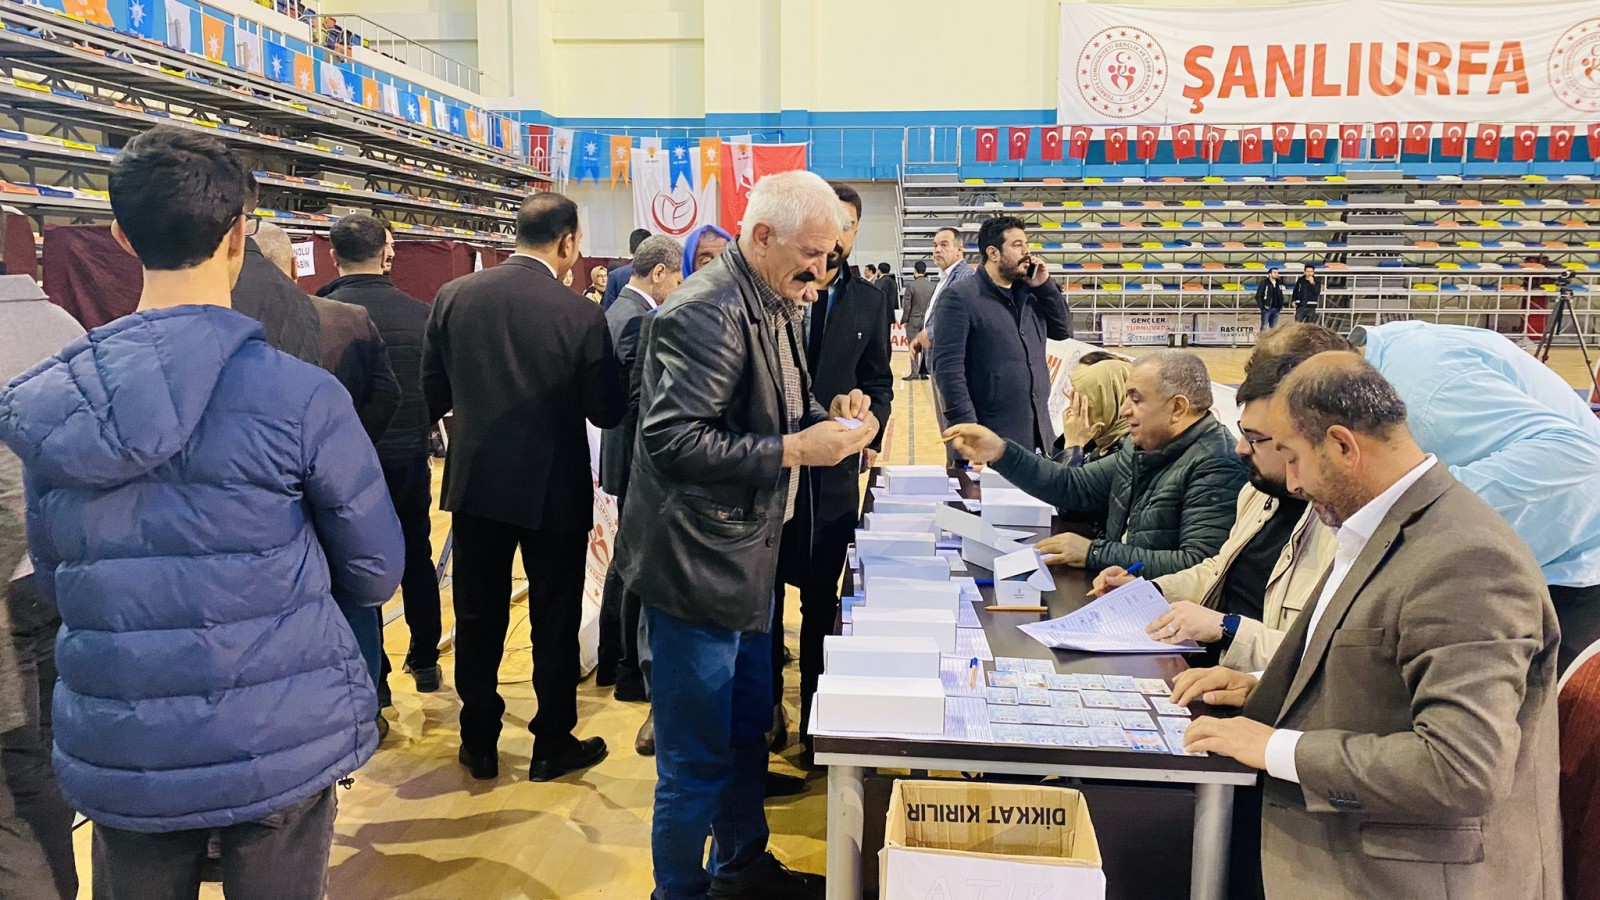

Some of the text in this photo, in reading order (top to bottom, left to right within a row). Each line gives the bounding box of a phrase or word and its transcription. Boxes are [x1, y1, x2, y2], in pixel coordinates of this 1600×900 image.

[1182, 41, 1530, 115] ŞANLIURFA
[907, 803, 1066, 829] DİKKAT KIRILIR
